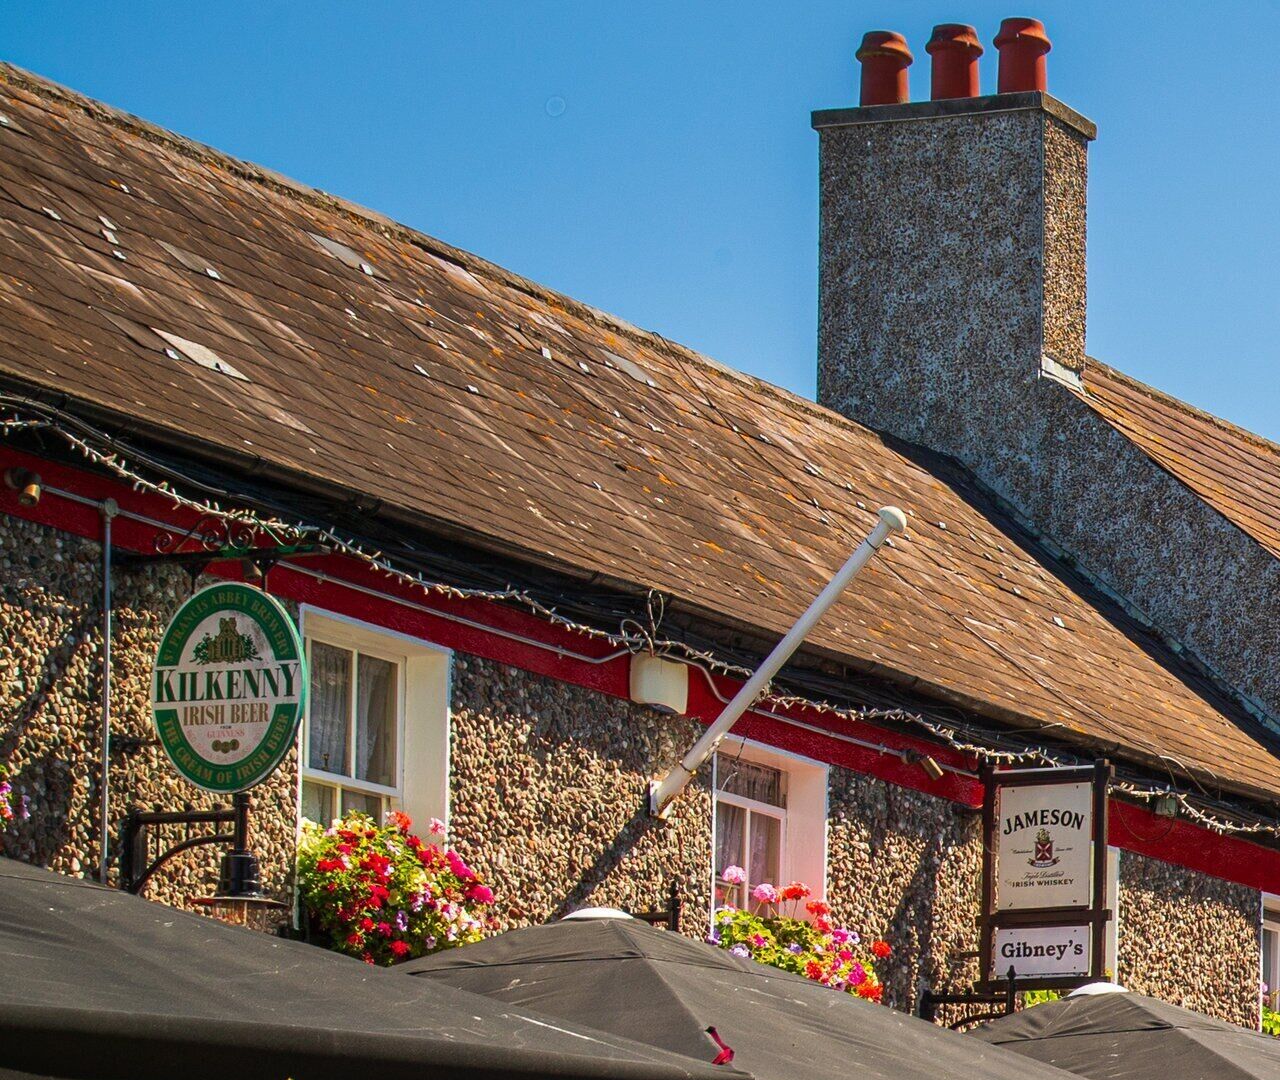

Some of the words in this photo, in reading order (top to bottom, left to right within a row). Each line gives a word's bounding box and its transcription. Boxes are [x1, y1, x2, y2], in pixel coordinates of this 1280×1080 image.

[168, 600, 209, 649] FRANCIS
[211, 591, 249, 607] ABBEY
[251, 600, 290, 656] BREWERY
[155, 662, 299, 703] KILKENNY
[183, 704, 225, 726] IRISH
[230, 702, 270, 724] BEER
[163, 718, 180, 744] THE
[176, 746, 213, 782] CREAM
[216, 769, 232, 783] OF
[236, 753, 271, 781] IRISH
[266, 713, 290, 752] BEER
[1003, 809, 1085, 835] JAMESON
[1012, 880, 1035, 888] IRISH
[1036, 878, 1074, 887] WHISKEY
[1001, 939, 1083, 960] Gibney's
